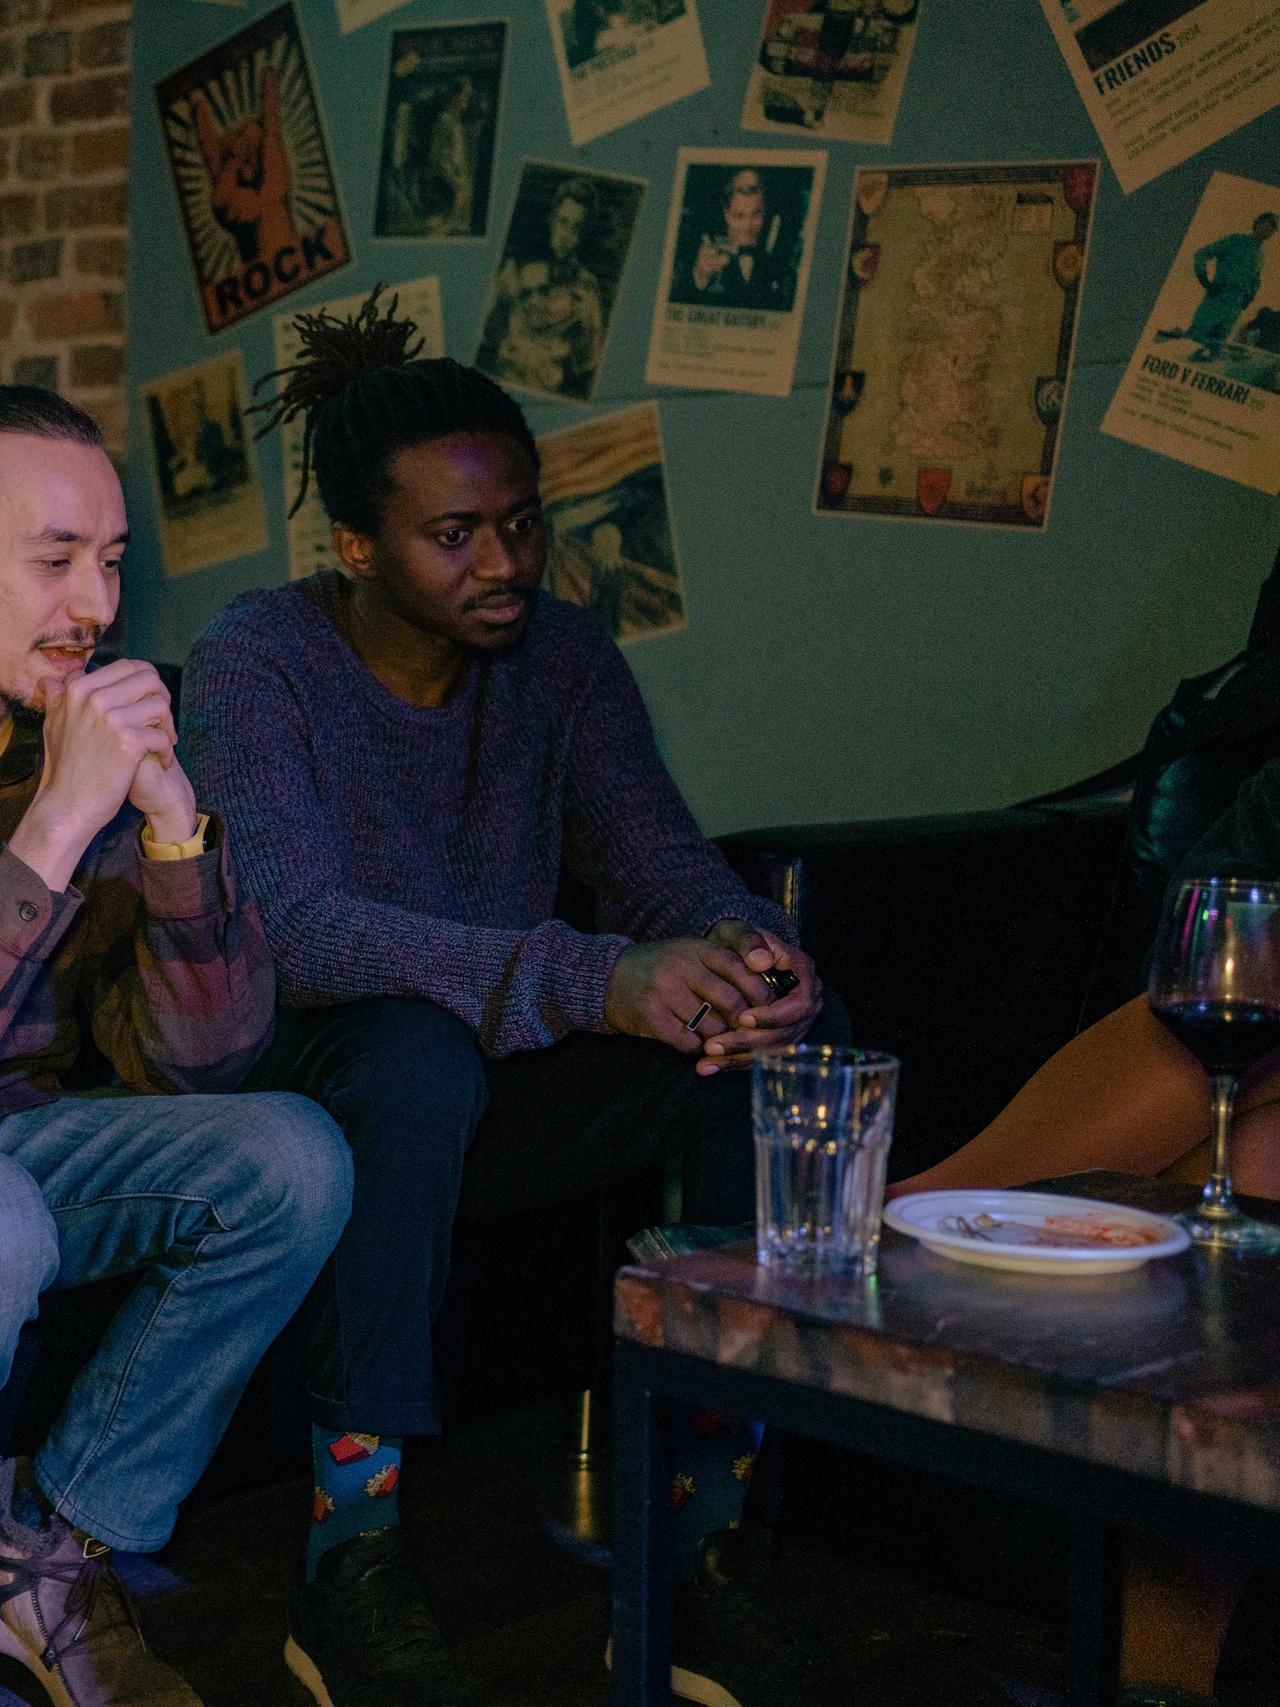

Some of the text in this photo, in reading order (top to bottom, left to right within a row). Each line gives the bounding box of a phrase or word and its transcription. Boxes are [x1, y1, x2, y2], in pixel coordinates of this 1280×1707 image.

[1093, 31, 1176, 96] FRIENDS
[216, 225, 334, 315] ROCK
[1142, 354, 1179, 380] FORD
[1180, 367, 1193, 385] V
[1190, 371, 1251, 405] FERRARI
